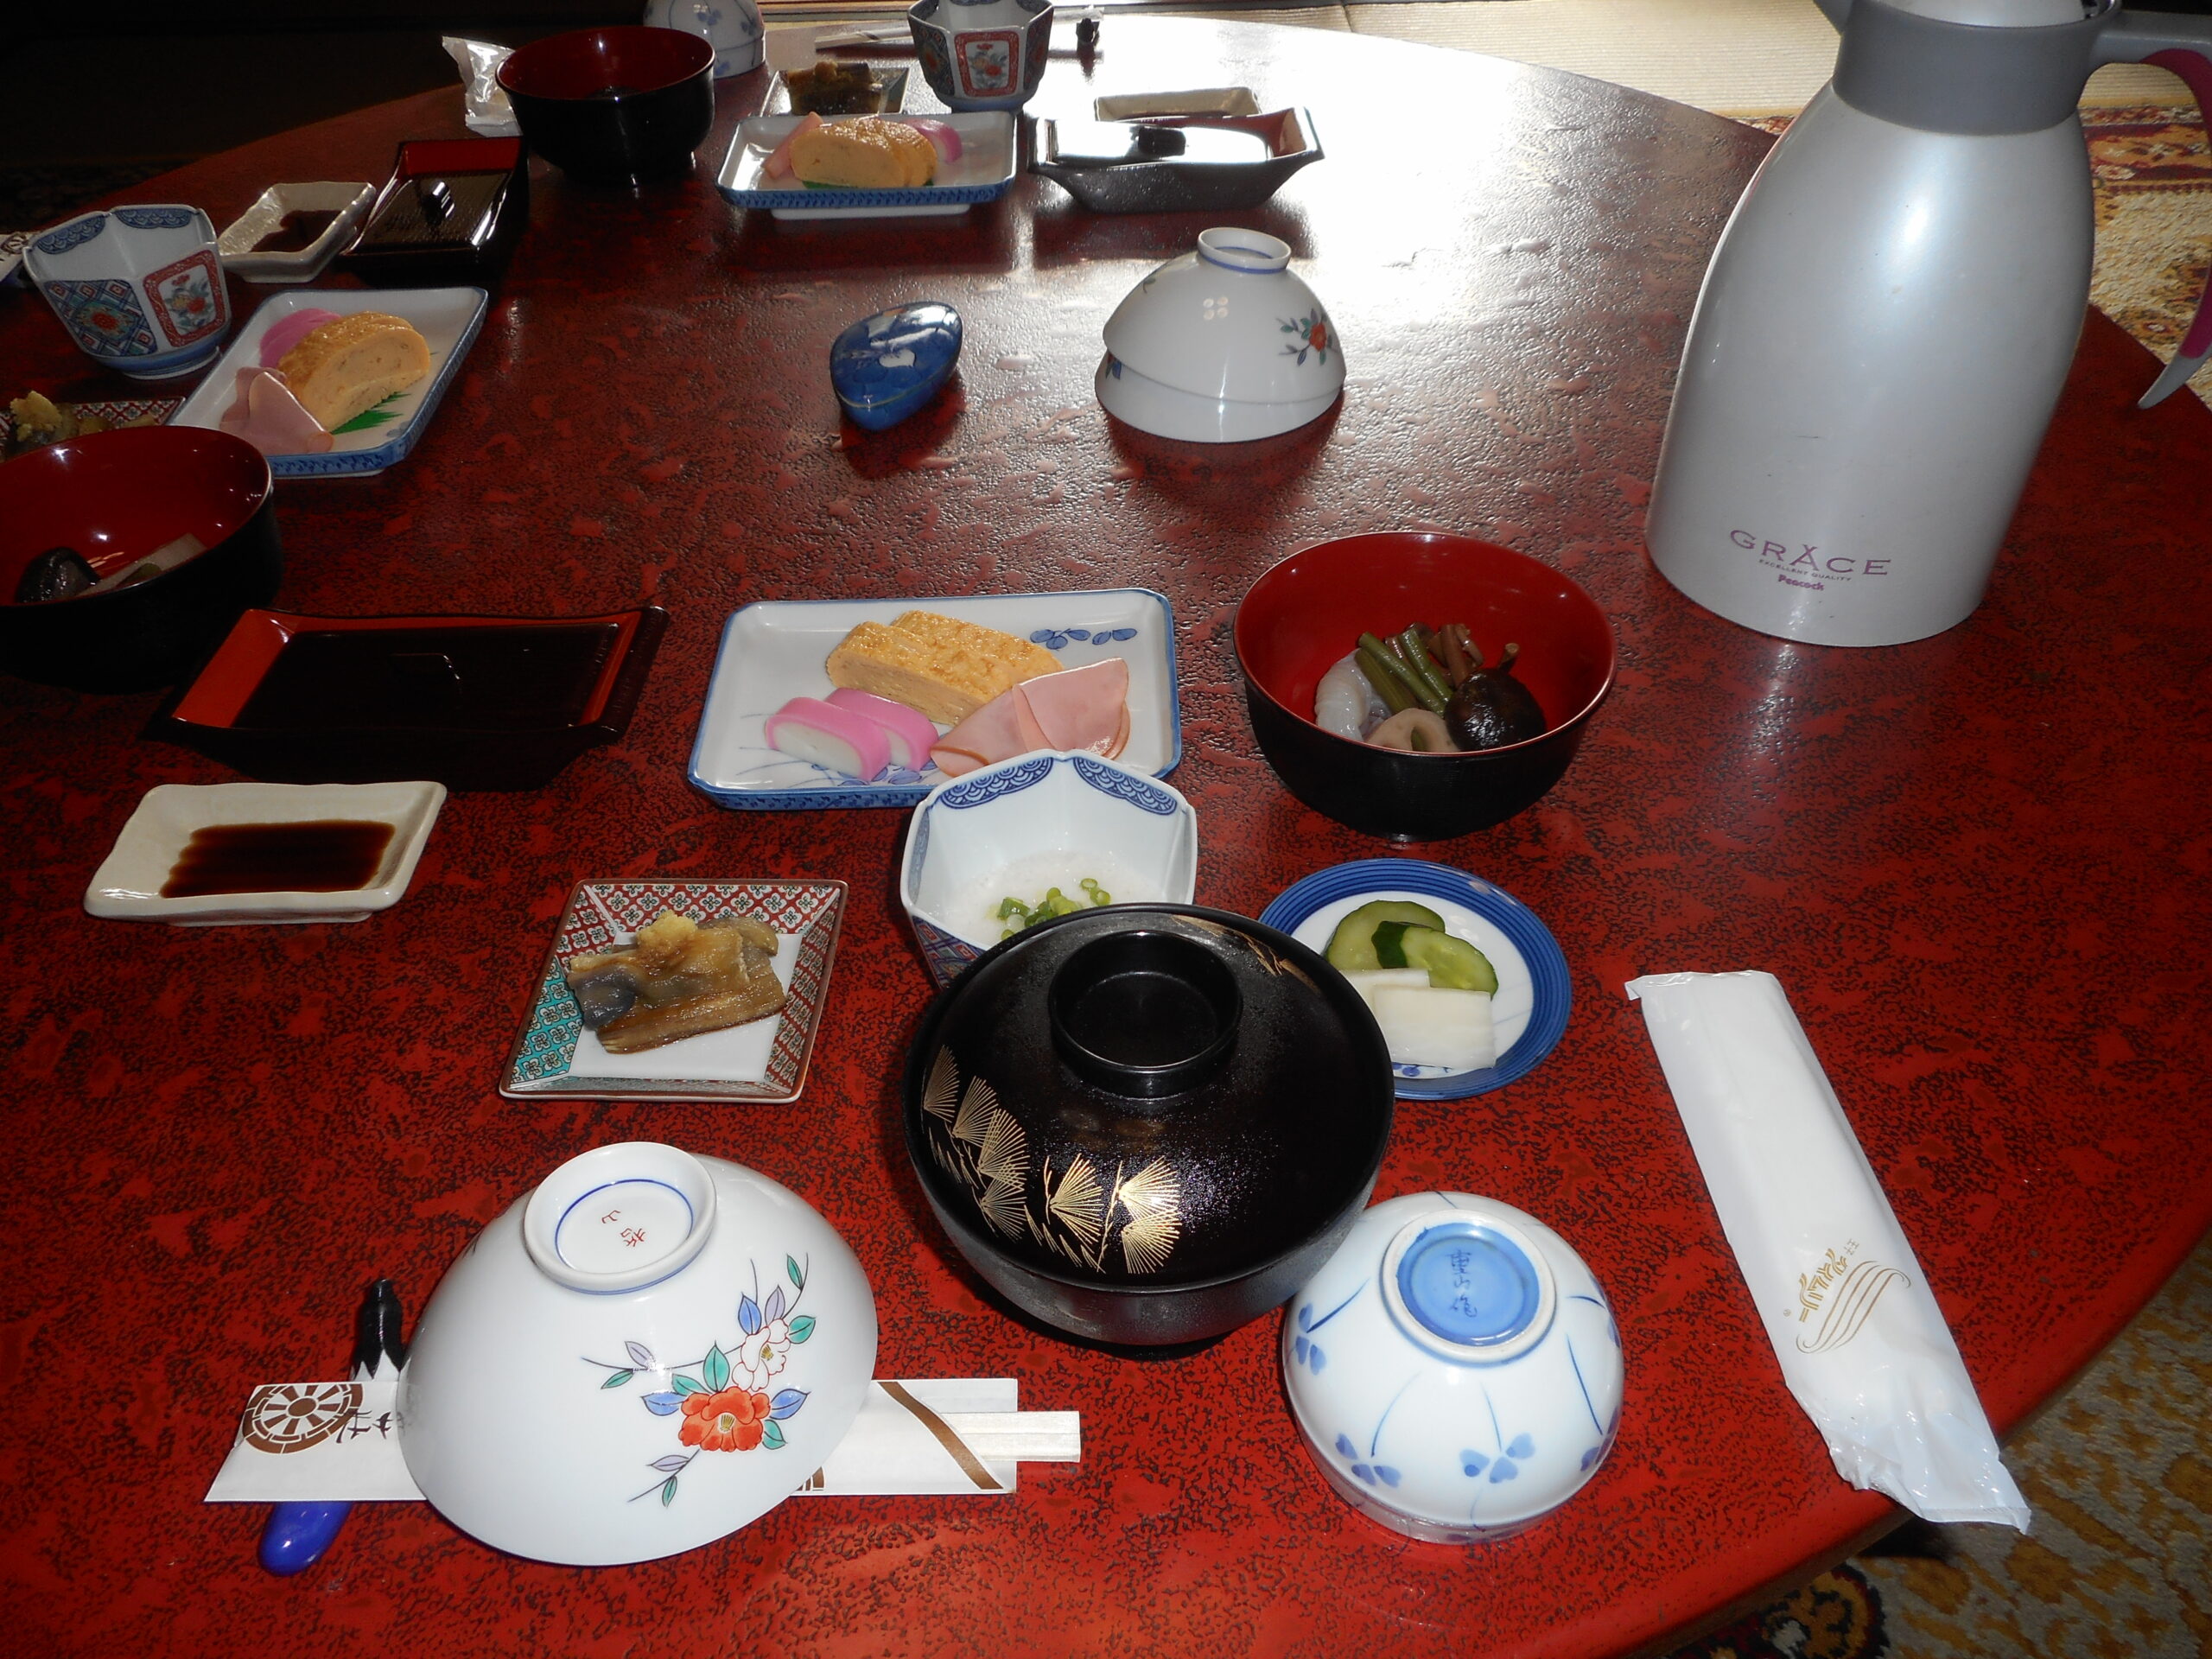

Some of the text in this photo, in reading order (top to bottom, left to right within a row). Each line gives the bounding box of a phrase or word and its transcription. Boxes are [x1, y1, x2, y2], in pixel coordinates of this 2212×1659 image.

[1730, 530, 1891, 575] GRACE
[1759, 559, 1852, 582] EXCELLENT QUALITY
[1778, 574, 1825, 591] Peacock
[1799, 1248, 1848, 1323] タイムリー
